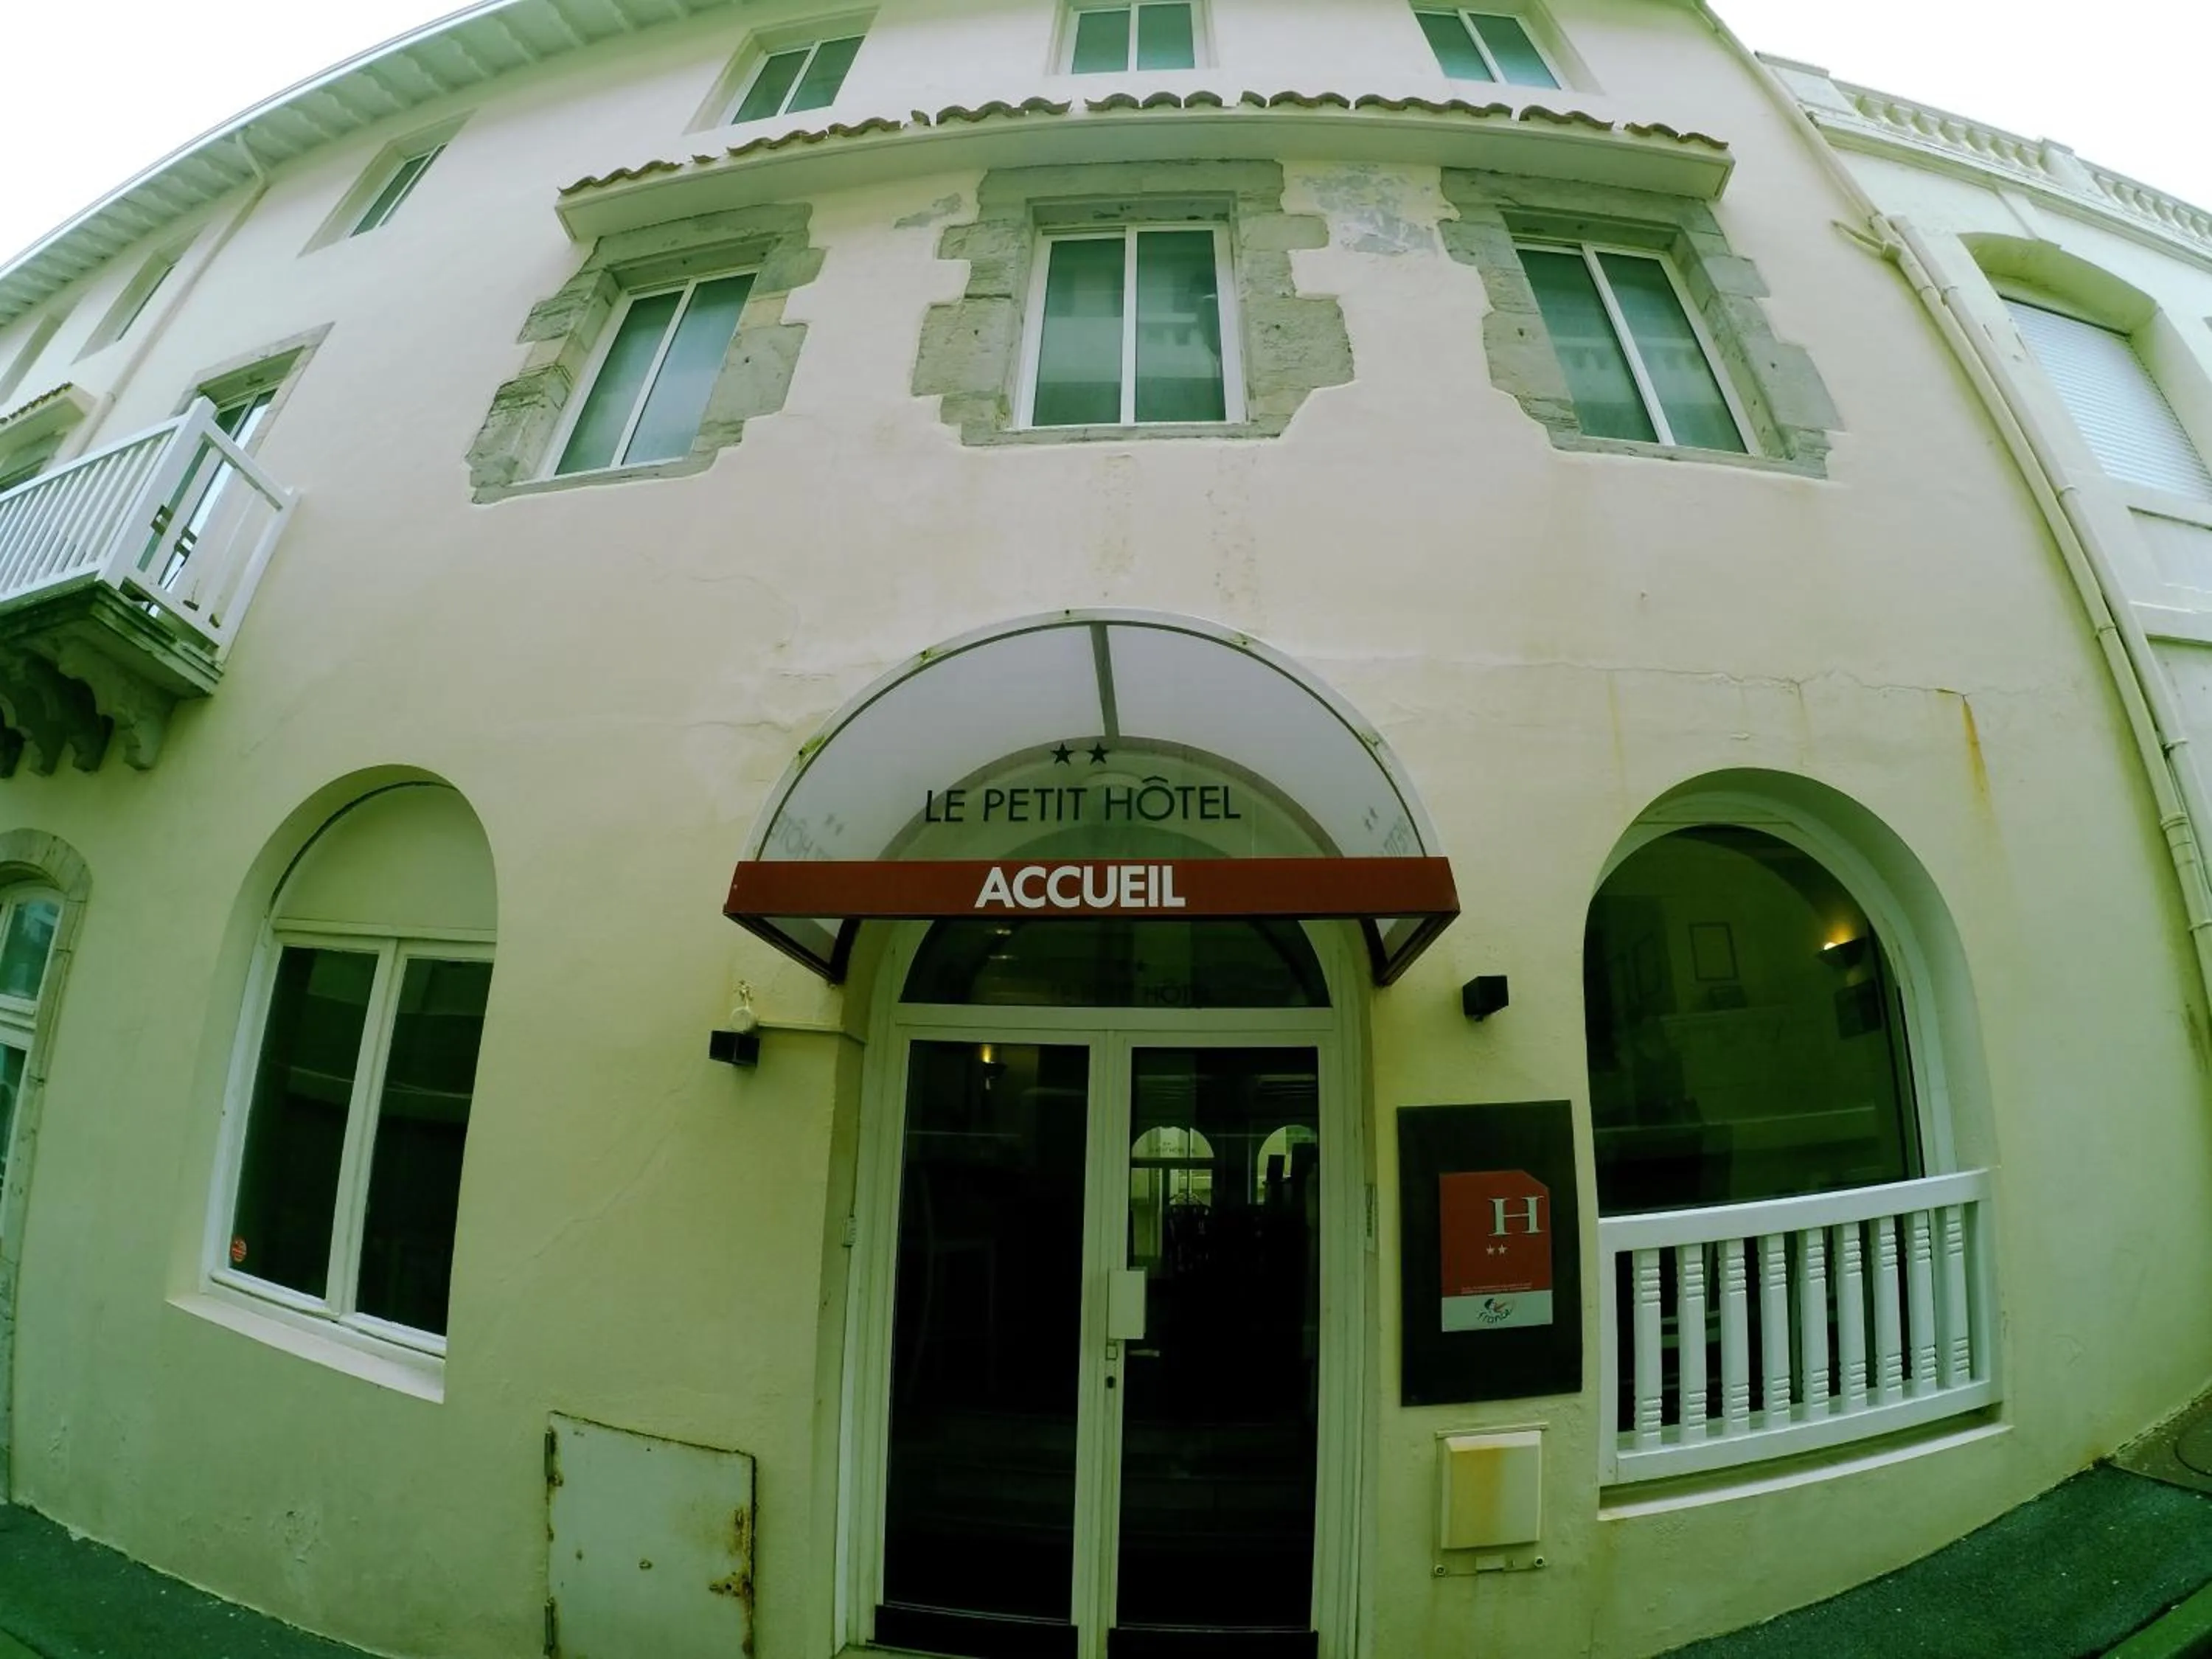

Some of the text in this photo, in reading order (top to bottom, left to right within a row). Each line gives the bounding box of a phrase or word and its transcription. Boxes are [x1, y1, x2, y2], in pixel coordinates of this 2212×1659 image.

[925, 776, 1242, 822] LE PETIT HÔTEL
[974, 865, 1186, 908] ACCUEIL
[1488, 1195, 1545, 1236] H
